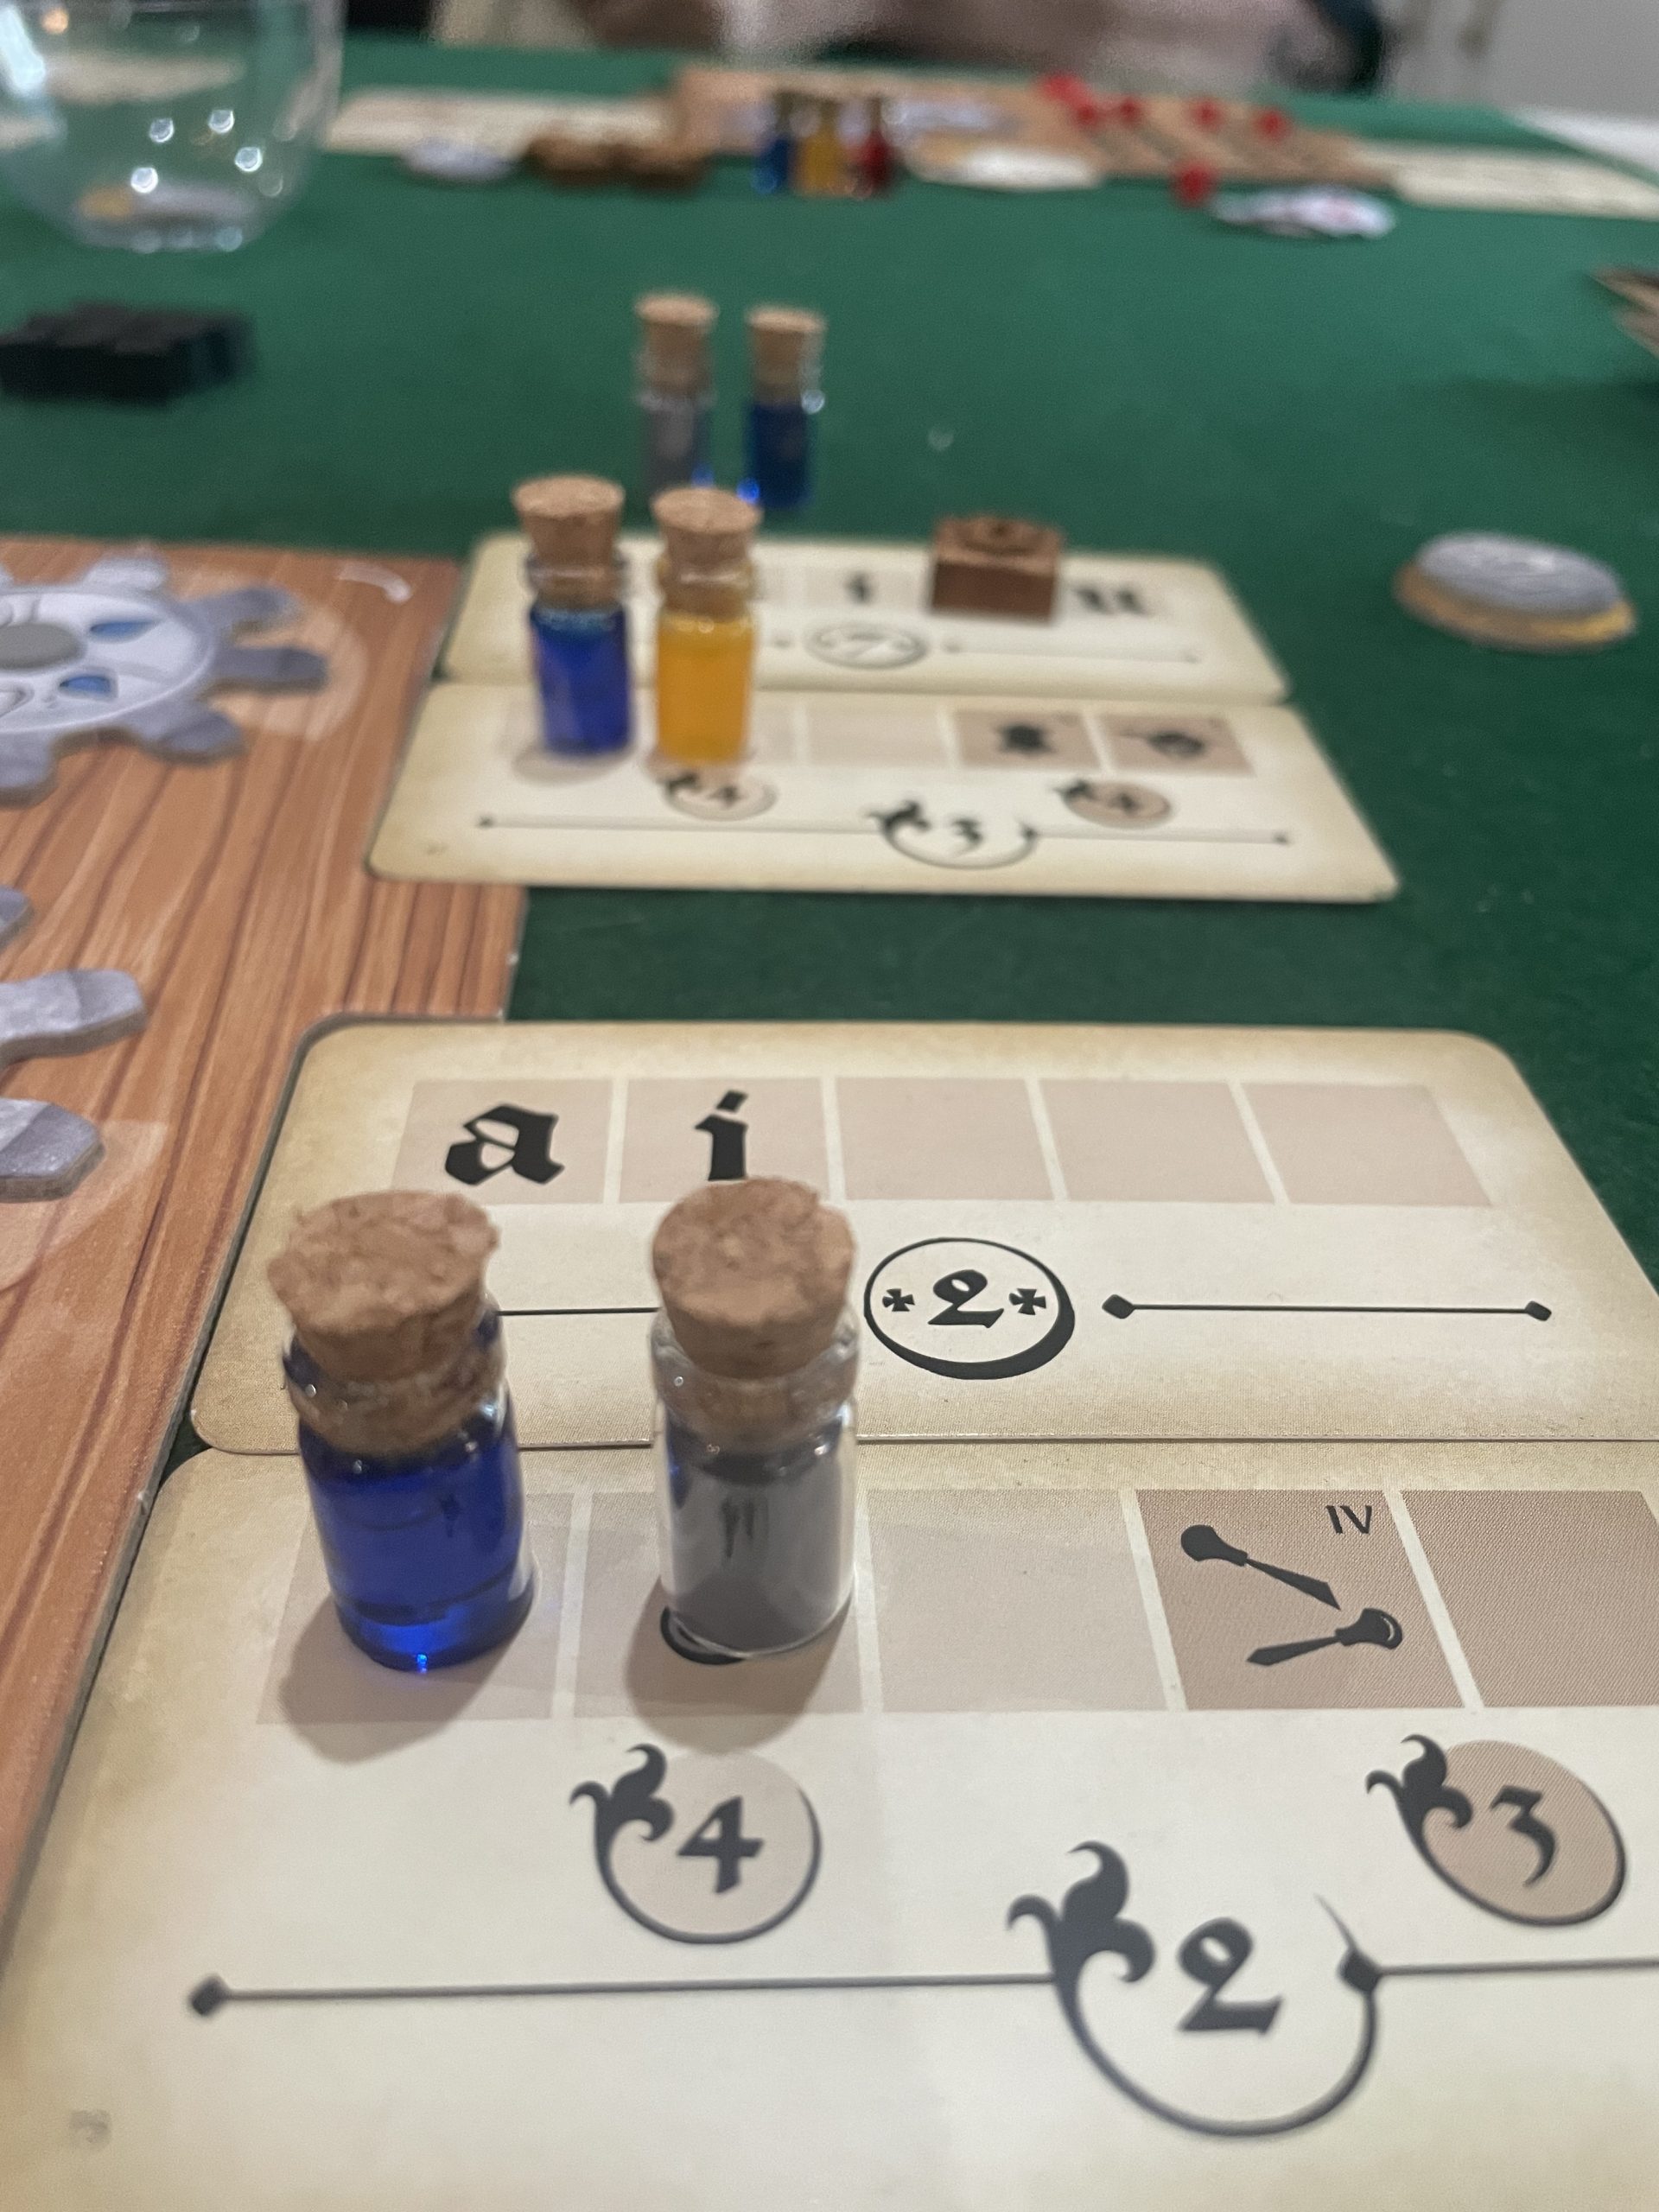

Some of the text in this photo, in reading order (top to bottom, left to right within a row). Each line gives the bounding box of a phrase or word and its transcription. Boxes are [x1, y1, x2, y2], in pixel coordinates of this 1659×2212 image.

[445, 1089, 750, 1187] a i
[926, 1268, 1005, 1329] 2
[1325, 1504, 1373, 1535] IV
[676, 1795, 765, 1895] 4
[1488, 1784, 1556, 1887] 3
[1175, 1916, 1284, 2036] 2
